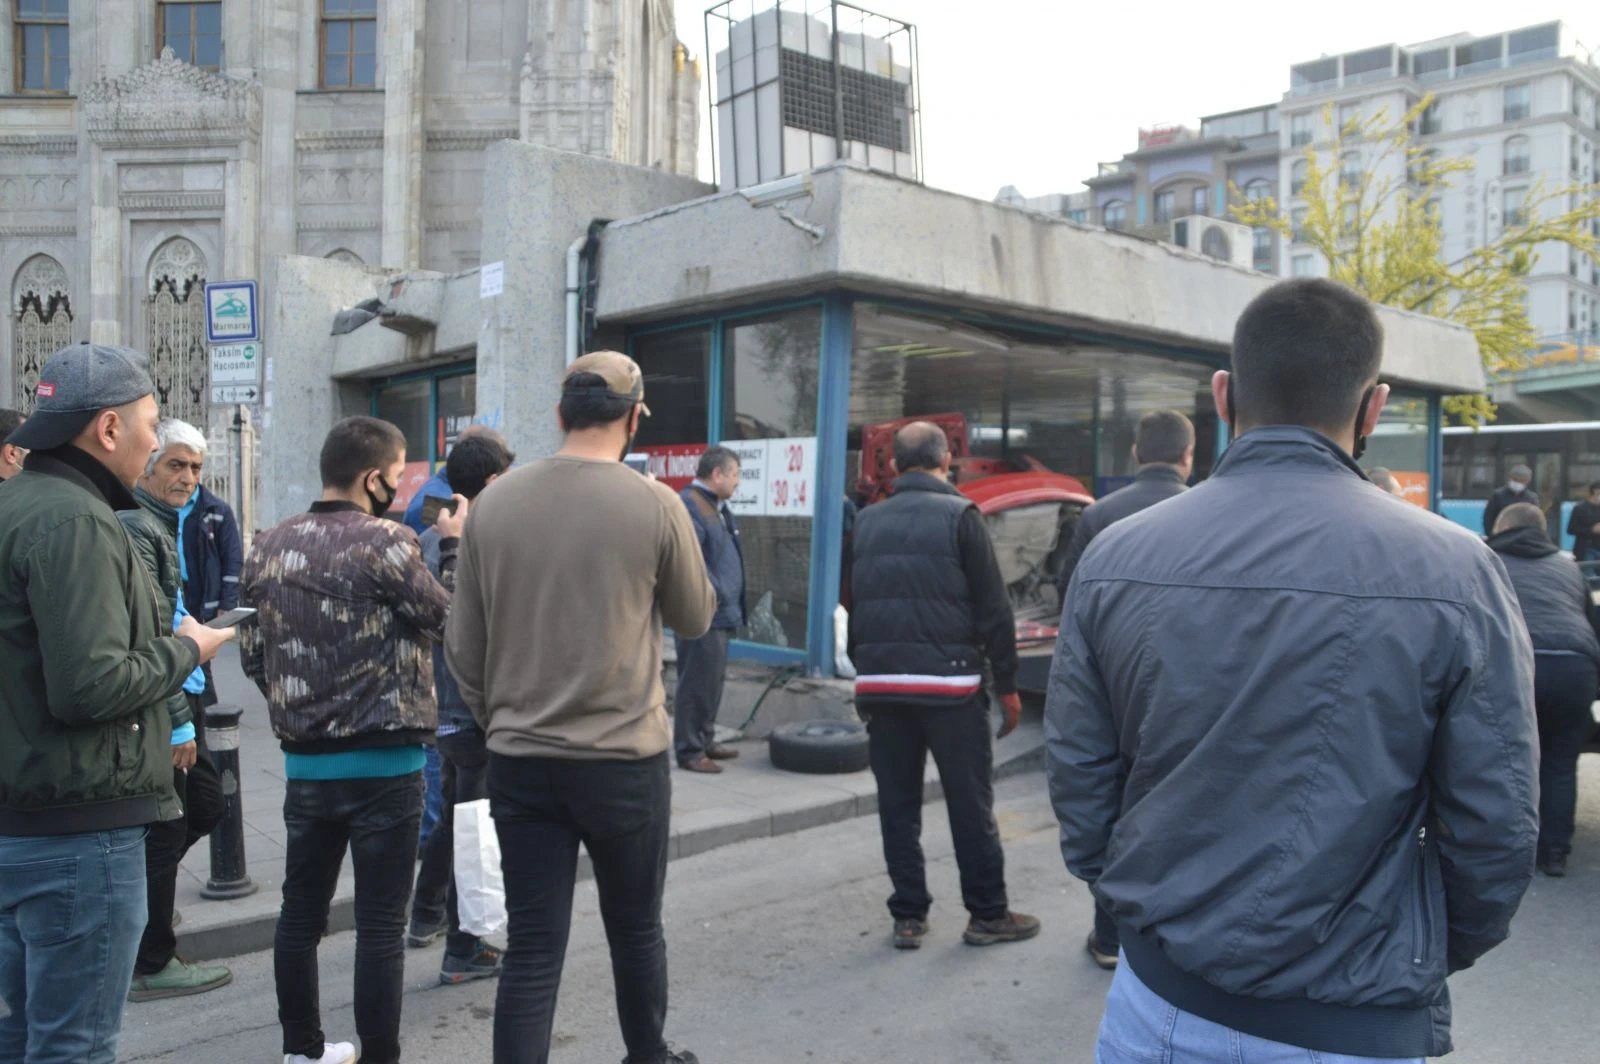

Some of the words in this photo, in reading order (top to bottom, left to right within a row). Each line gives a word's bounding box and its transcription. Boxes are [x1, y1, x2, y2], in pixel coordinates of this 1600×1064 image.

[213, 322, 251, 331] Marmaray
[213, 346, 242, 358] Taksim
[667, 448, 702, 478] İNDİRİ
